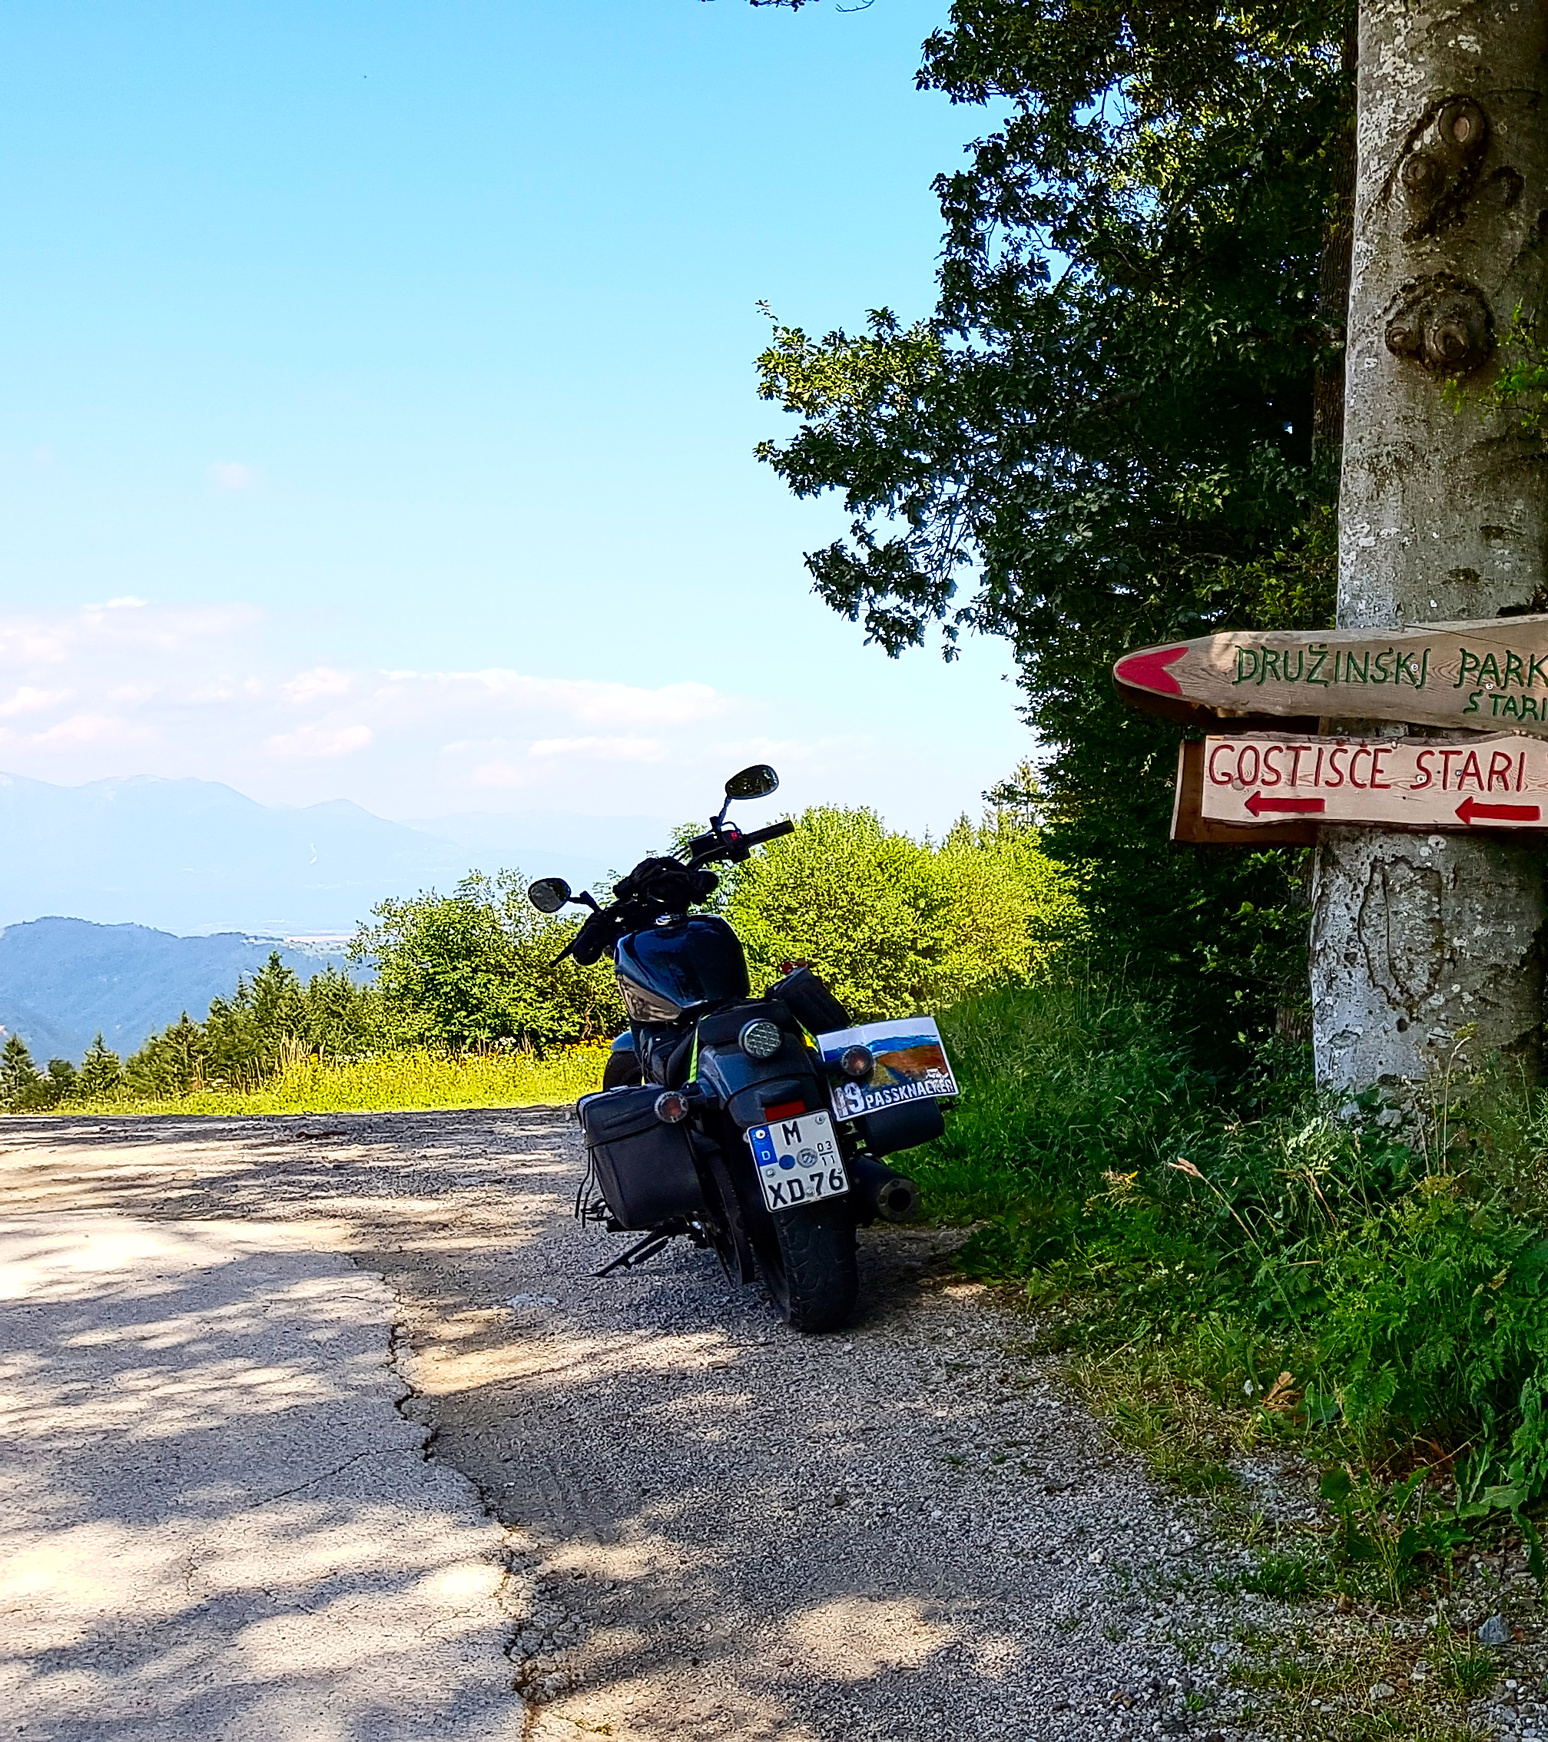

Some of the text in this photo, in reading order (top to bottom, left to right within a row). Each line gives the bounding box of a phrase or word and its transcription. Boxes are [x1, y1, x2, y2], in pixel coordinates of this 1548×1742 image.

[1463, 689, 1548, 721] STARI
[1209, 740, 1392, 789] GOSTIŠČE
[1410, 750, 1525, 792] STARI
[782, 1121, 802, 1146] M
[817, 1141, 833, 1152] 03
[761, 1150, 771, 1161] D
[768, 1168, 844, 1208] XD 76
